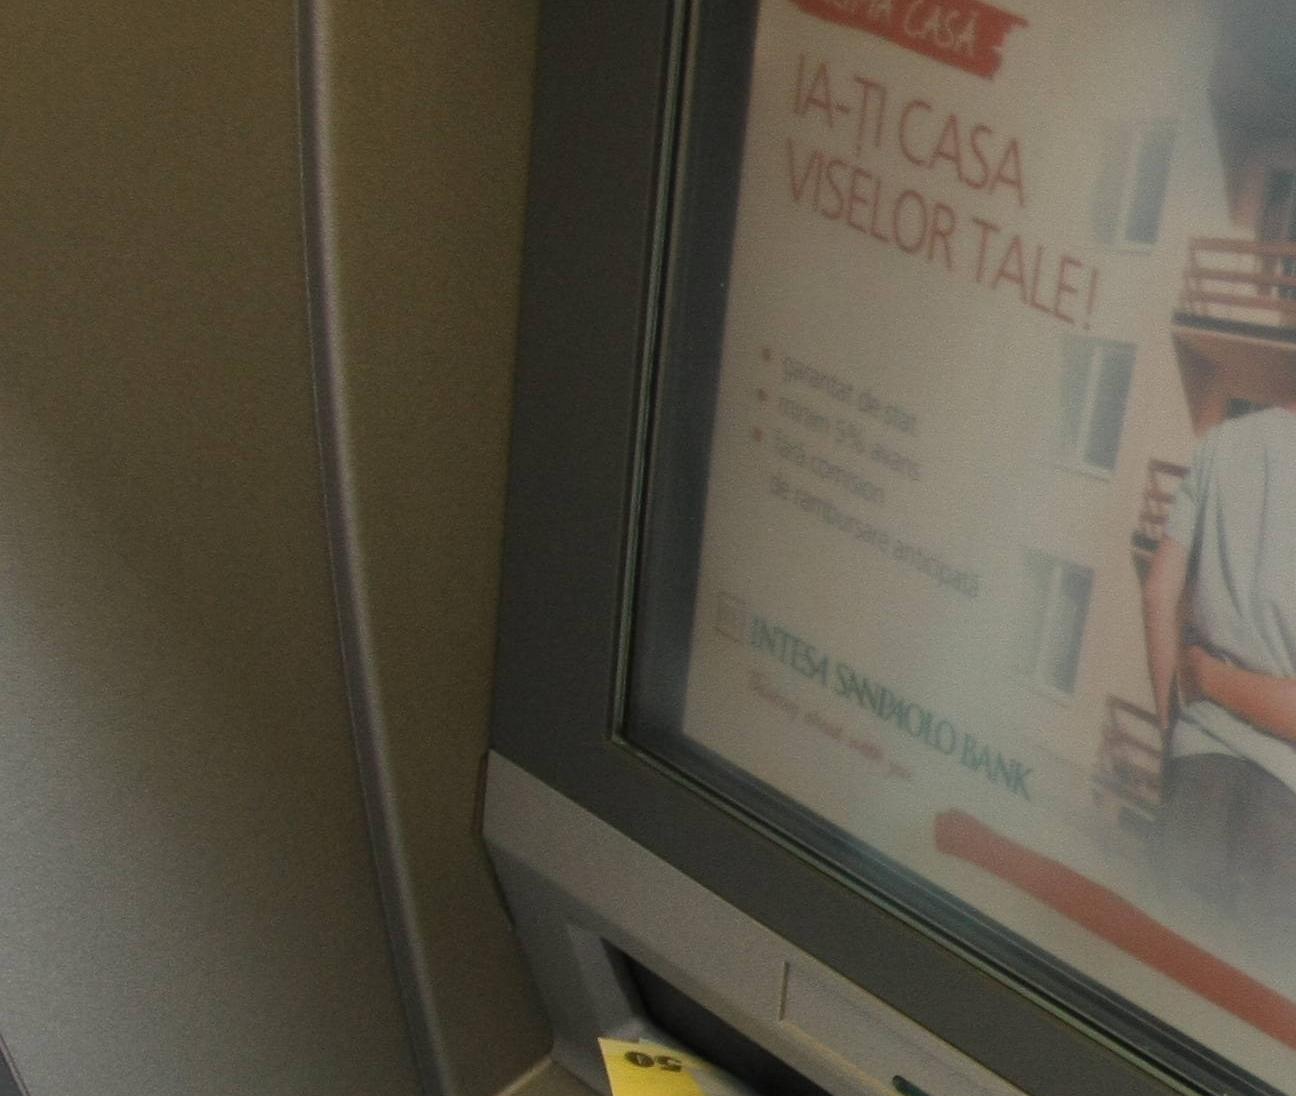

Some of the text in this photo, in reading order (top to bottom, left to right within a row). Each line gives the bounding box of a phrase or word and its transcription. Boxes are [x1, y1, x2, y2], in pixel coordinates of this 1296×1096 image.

[785, 138, 1101, 330] VISELOR TALE!
[898, 99, 1027, 208] CASA
[751, 615, 829, 688] INTESA
[833, 662, 957, 756] SANPAOLO
[961, 733, 1032, 801] BANK
